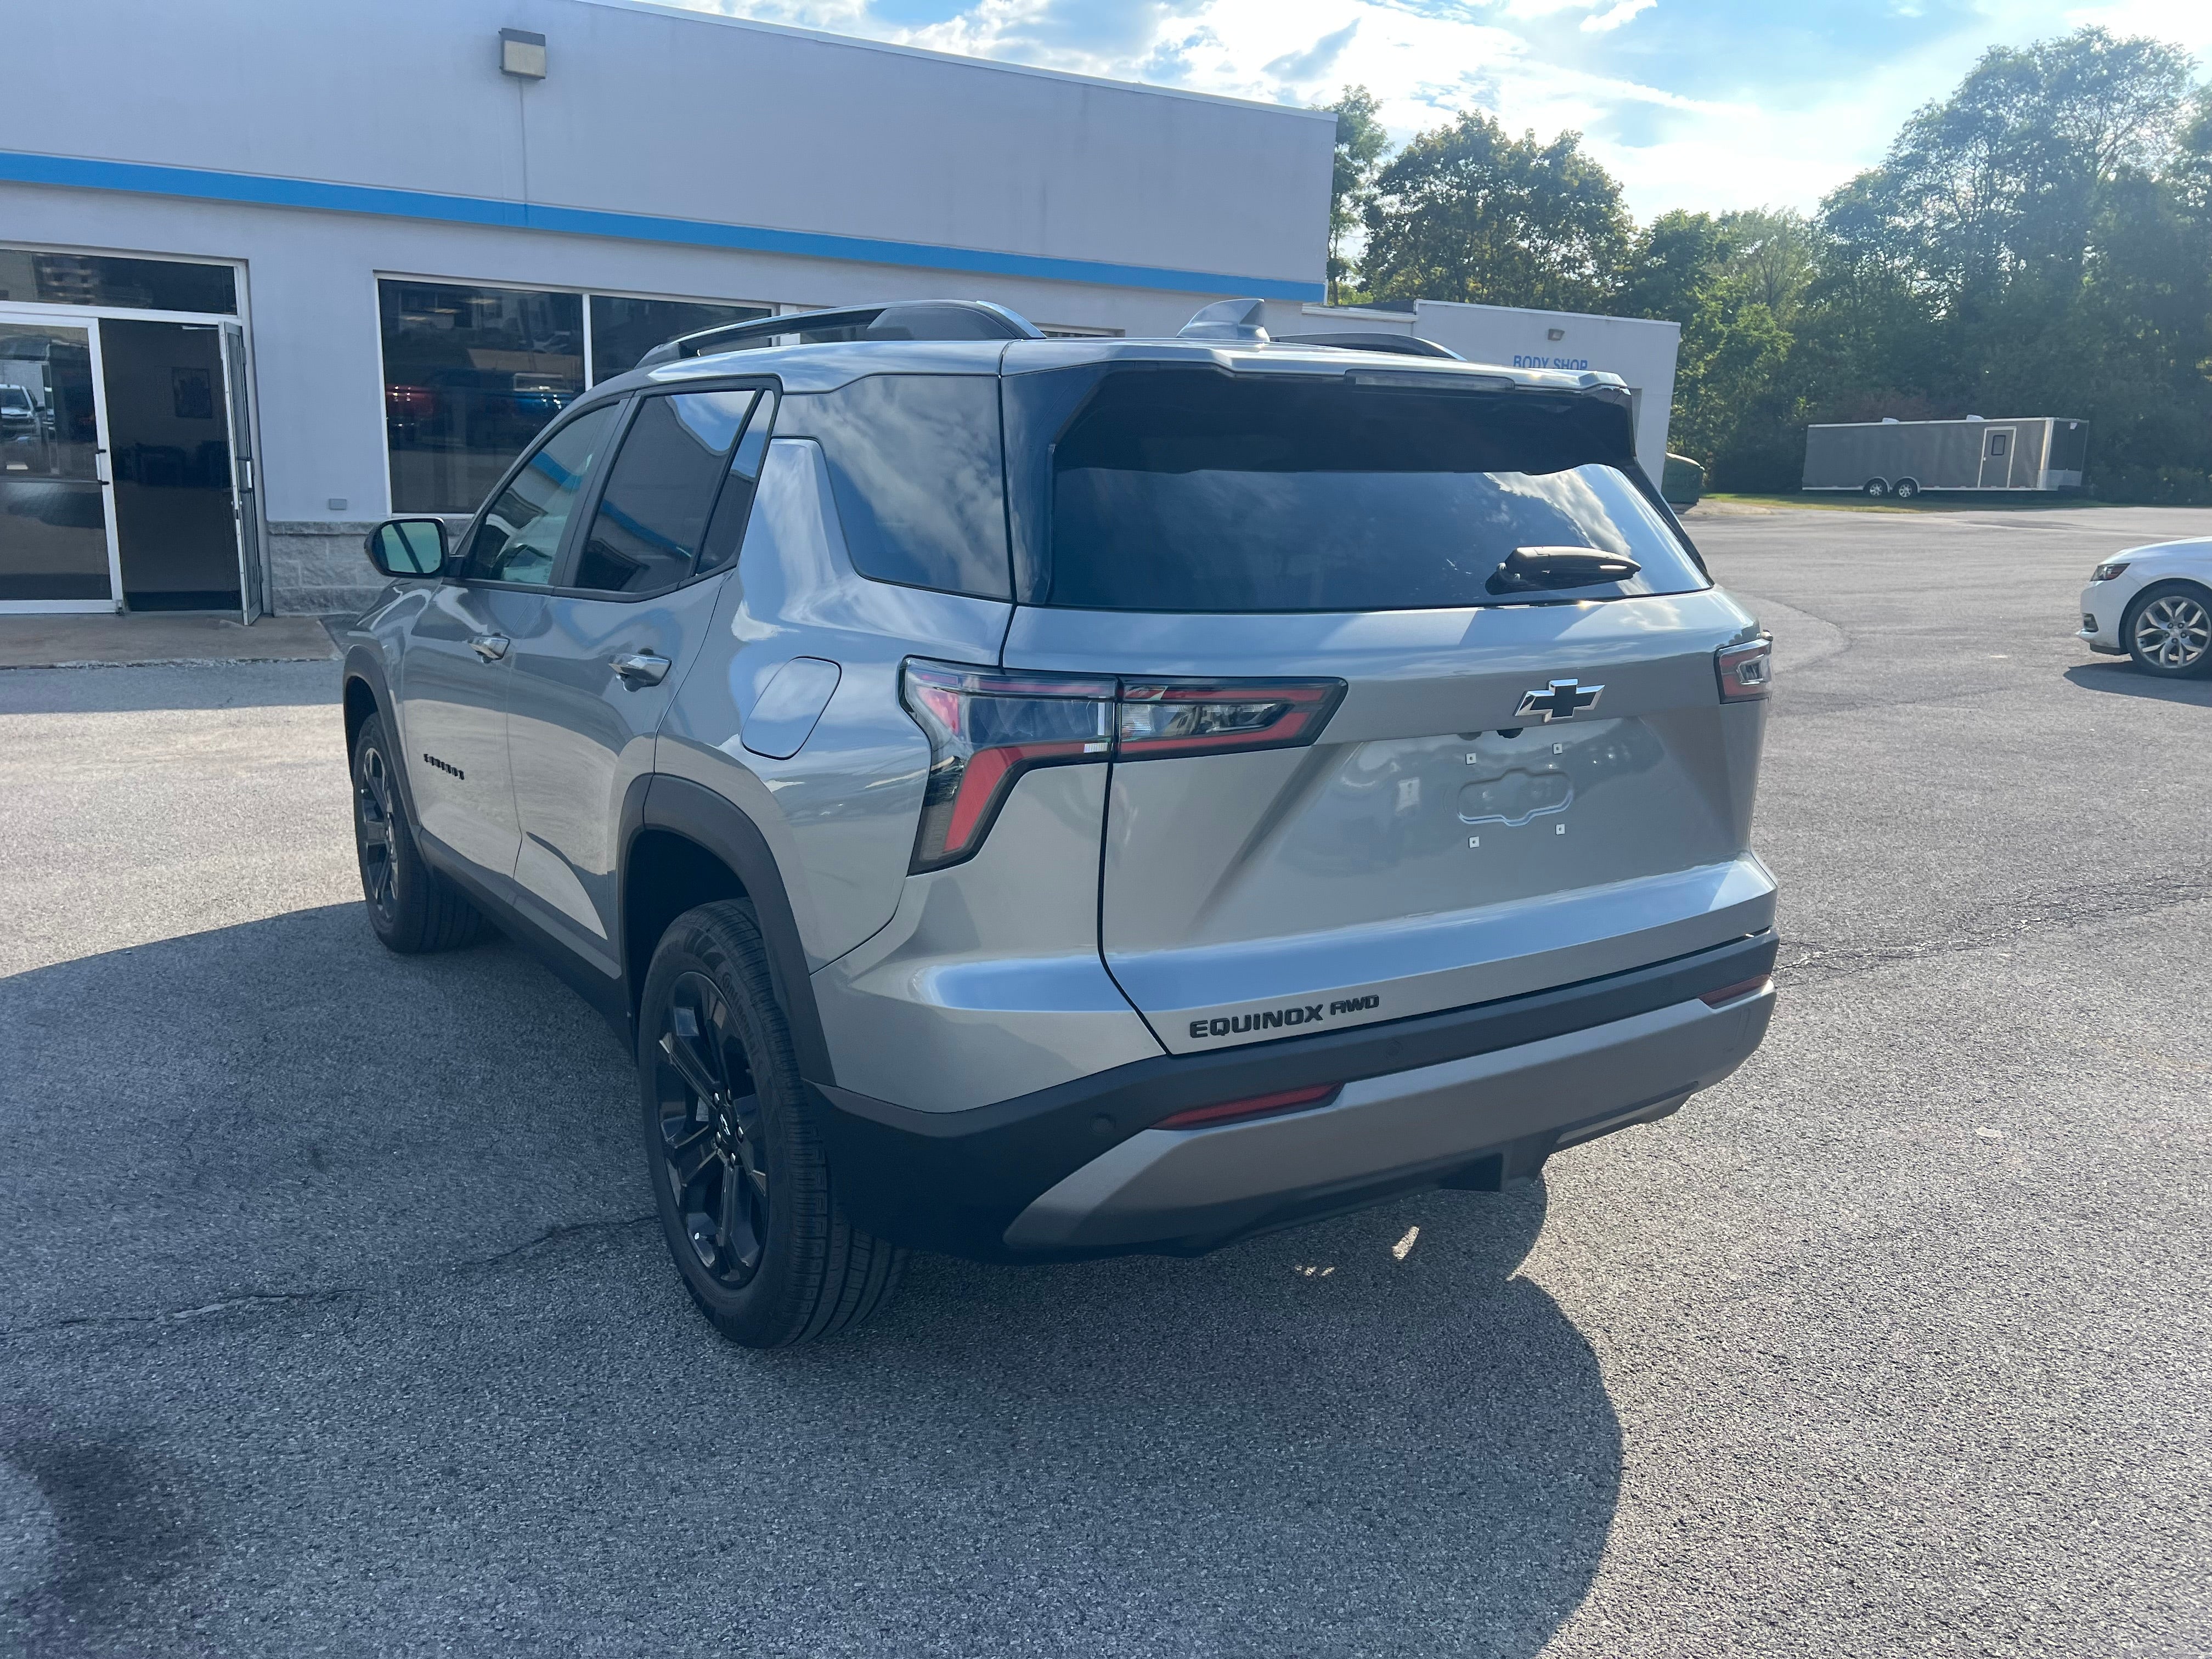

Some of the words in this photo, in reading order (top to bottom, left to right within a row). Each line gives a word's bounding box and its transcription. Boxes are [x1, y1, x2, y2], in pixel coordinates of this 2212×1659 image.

[1514, 356, 1549, 368] BODY
[1554, 358, 1588, 370] SHOP
[1190, 1005, 1323, 1038] EQUINOX
[1330, 995, 1379, 1015] AWD
